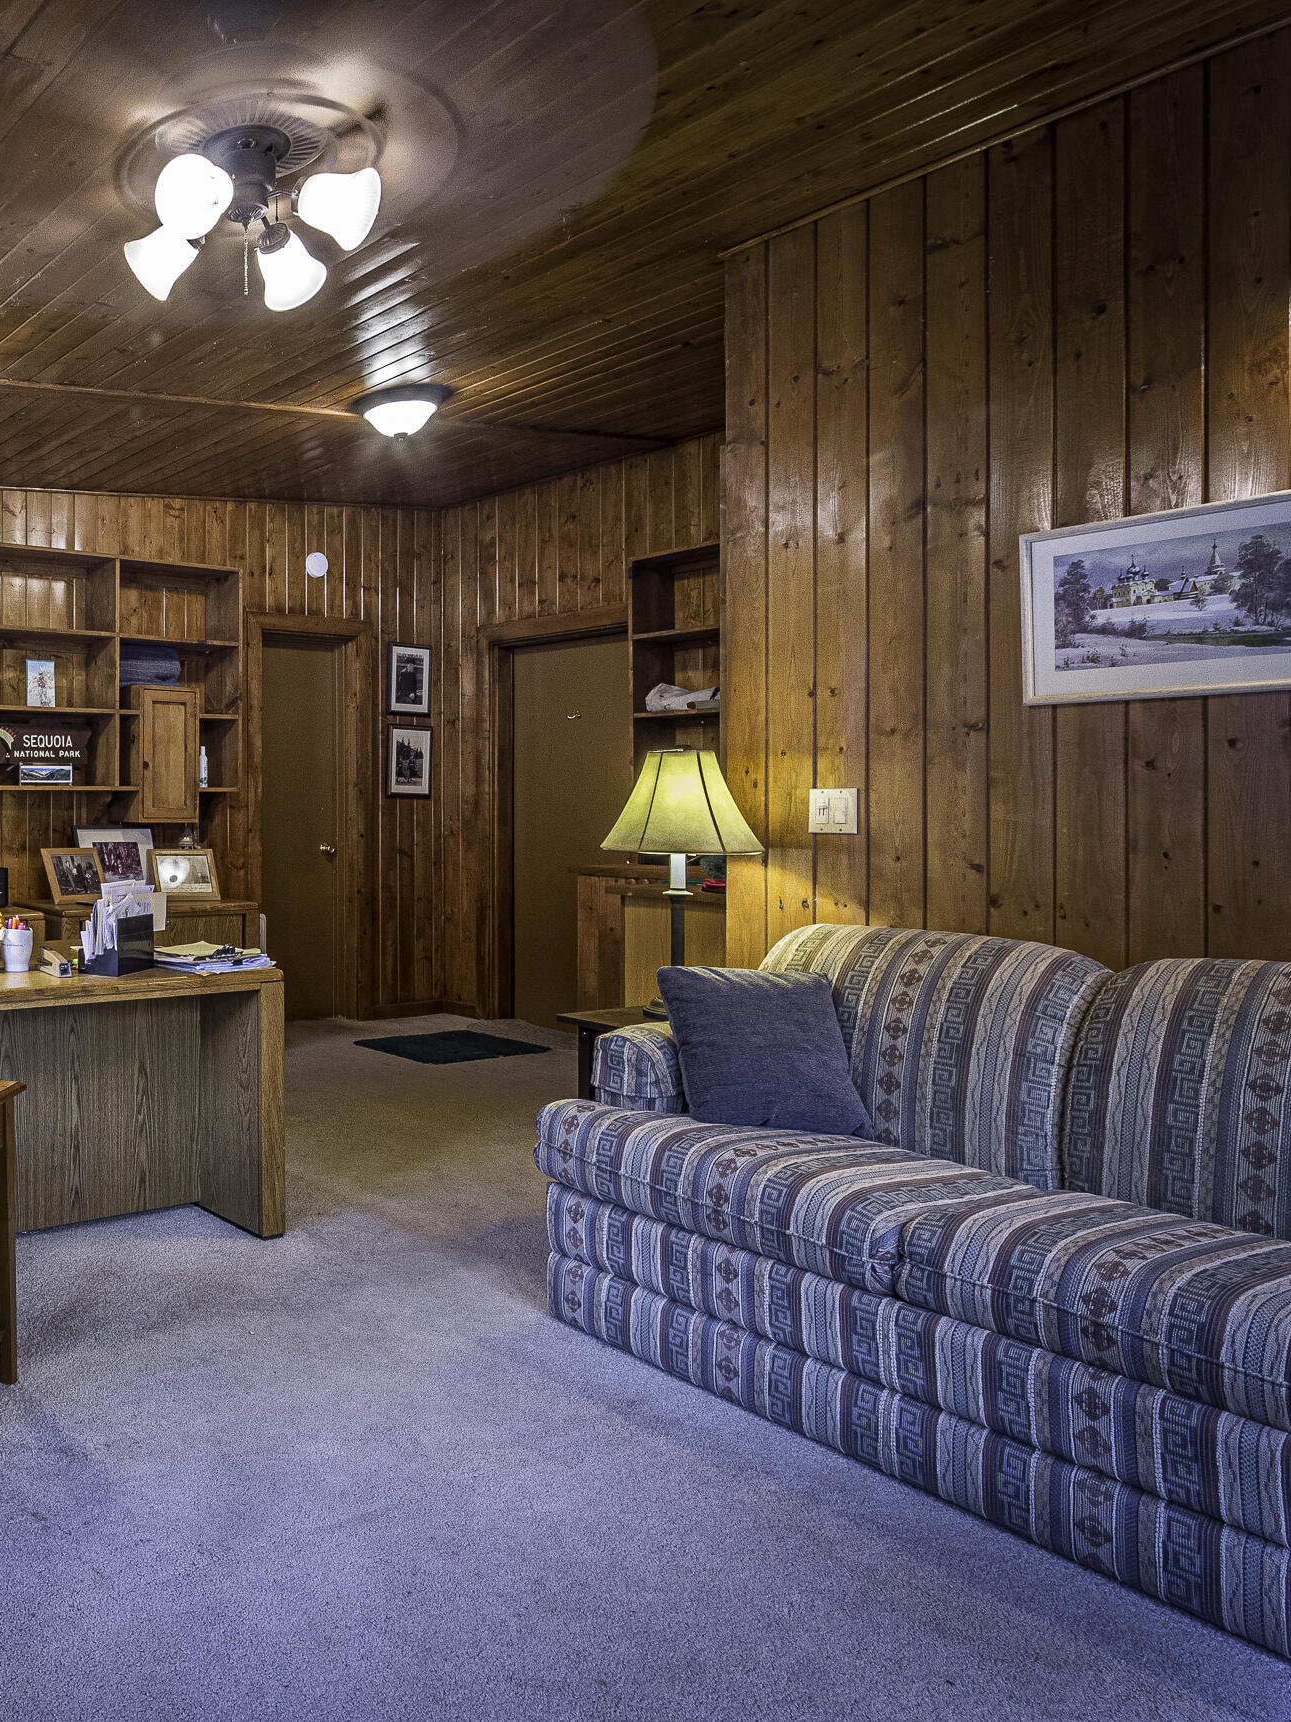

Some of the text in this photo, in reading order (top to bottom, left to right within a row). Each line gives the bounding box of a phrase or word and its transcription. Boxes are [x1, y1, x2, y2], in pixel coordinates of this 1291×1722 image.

[22, 734, 73, 748] SEQUOIA
[13, 750, 81, 758] NATIONAL PARK
